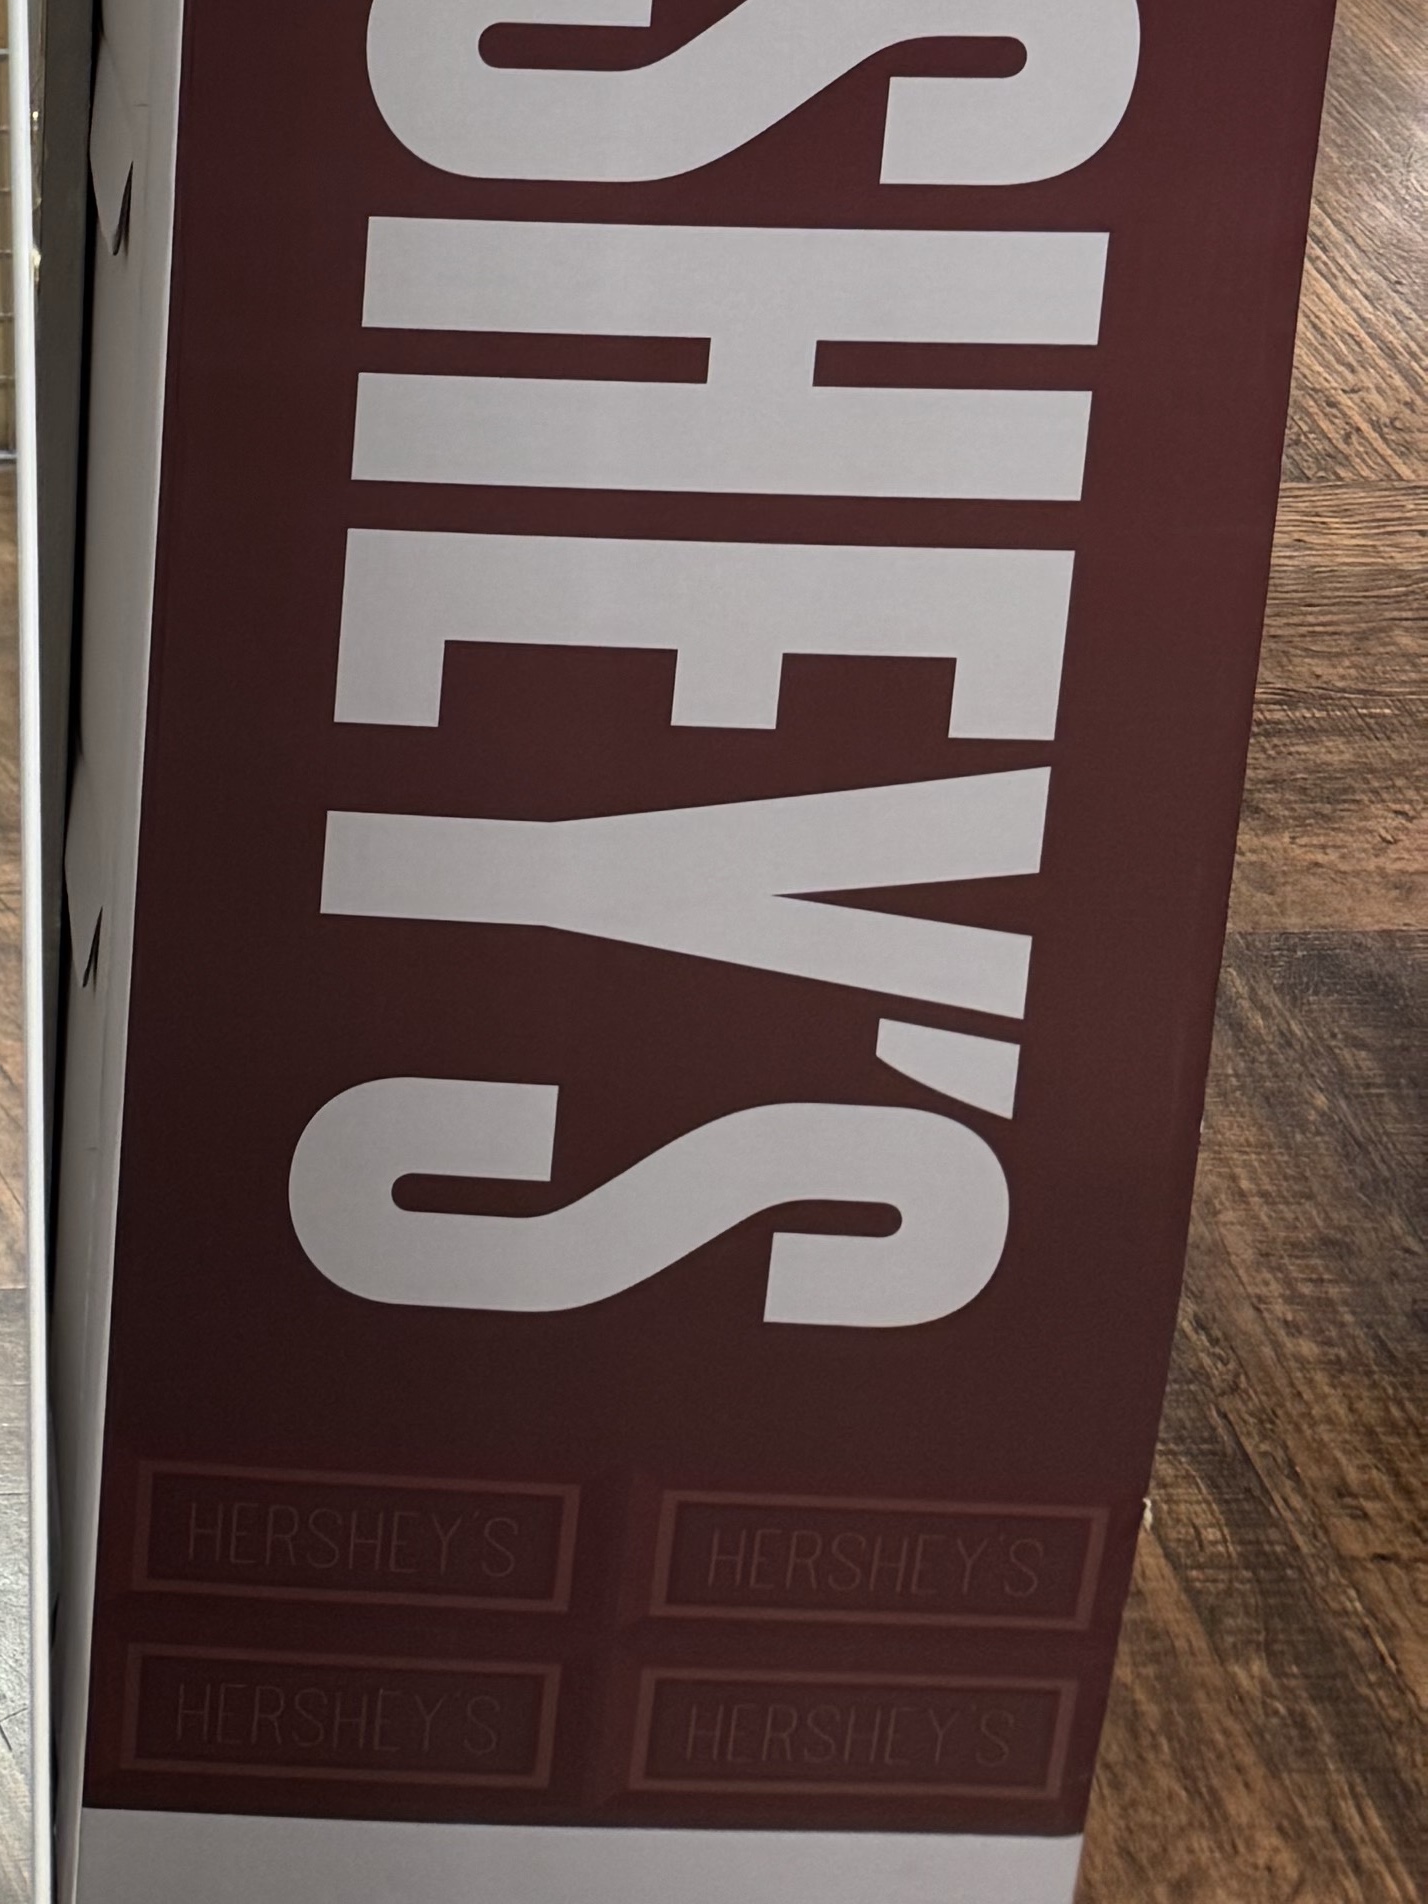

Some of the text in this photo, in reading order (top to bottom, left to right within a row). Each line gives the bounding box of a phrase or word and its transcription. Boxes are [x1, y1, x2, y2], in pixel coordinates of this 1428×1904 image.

[186, 1500, 524, 1580] HERSHEY'S
[706, 1526, 1046, 1602] HERSHEY'S
[174, 1679, 502, 1761] HERSHEY'S
[682, 1699, 1016, 1769] HERSHEY'S
